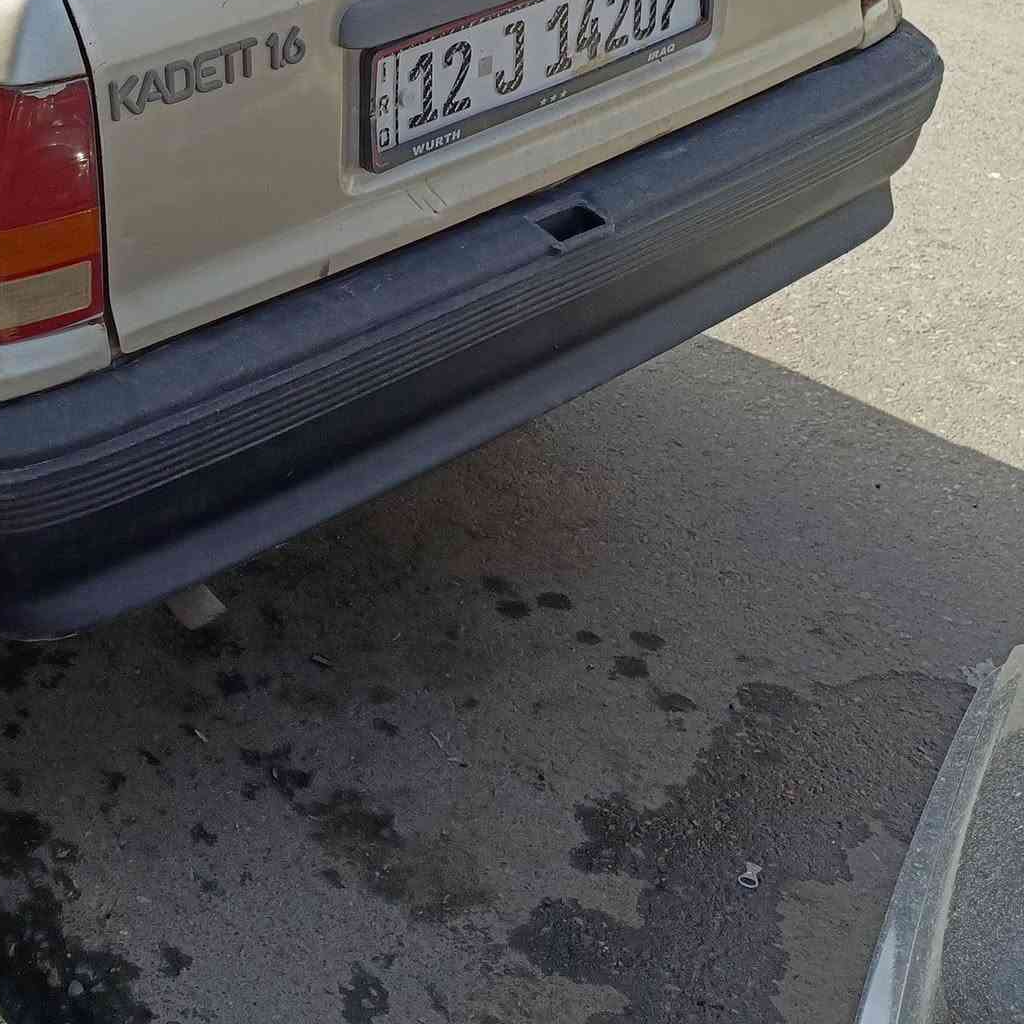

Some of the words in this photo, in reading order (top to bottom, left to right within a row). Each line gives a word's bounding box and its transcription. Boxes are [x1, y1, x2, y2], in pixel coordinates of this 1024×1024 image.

[108, 36, 258, 121] KADETT
[408, 40, 472, 130] 12
[495, 19, 527, 96] J
